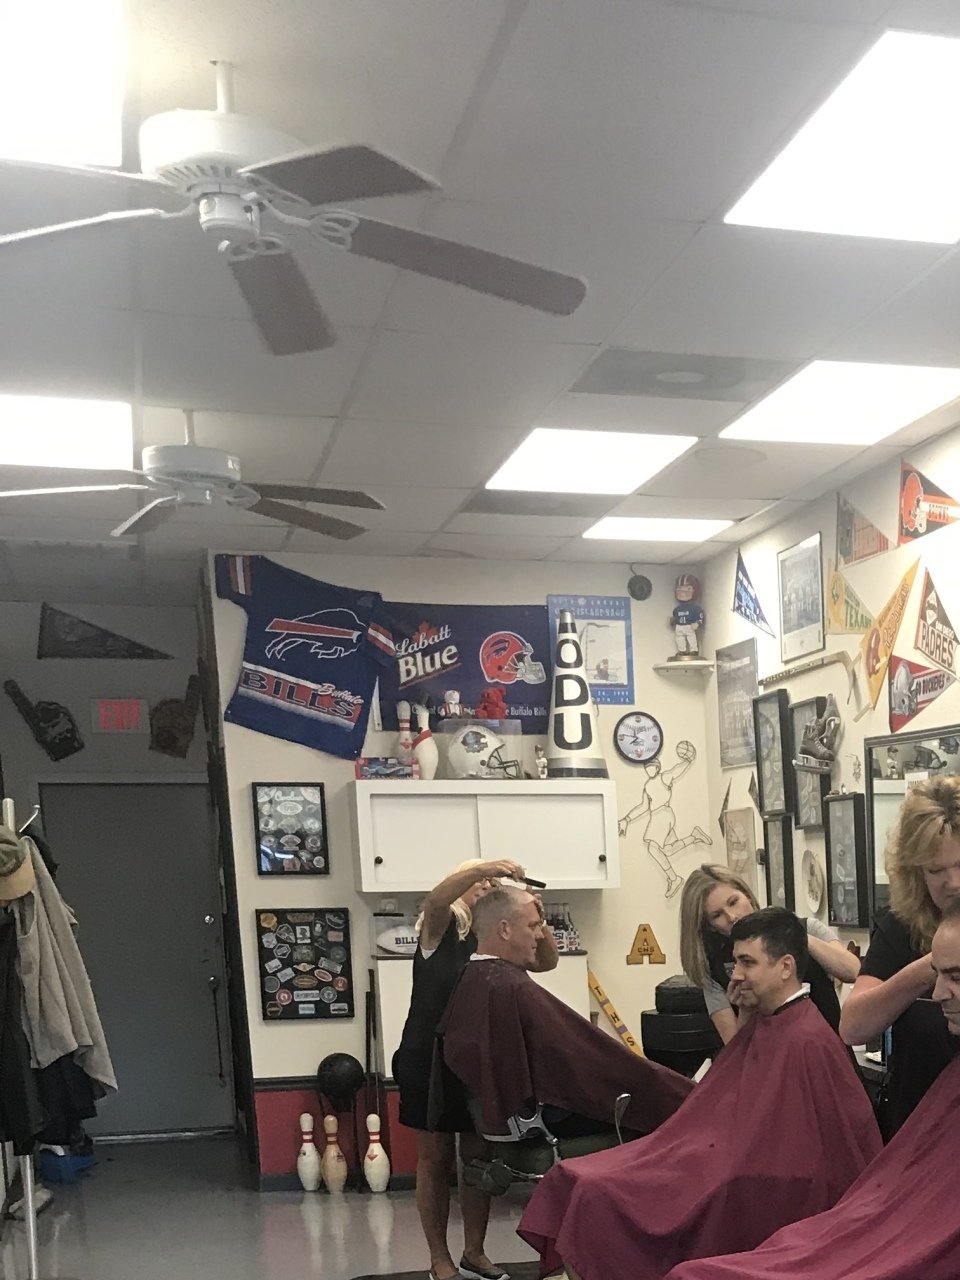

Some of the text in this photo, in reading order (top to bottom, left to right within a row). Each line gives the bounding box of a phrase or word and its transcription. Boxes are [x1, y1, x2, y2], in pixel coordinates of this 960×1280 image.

[396, 624, 452, 658] Labatt
[921, 623, 955, 669] PADRES
[398, 645, 459, 684] Blue
[242, 669, 354, 718] BILLS
[511, 706, 533, 717] Buffalo
[554, 638, 593, 750] ODU
